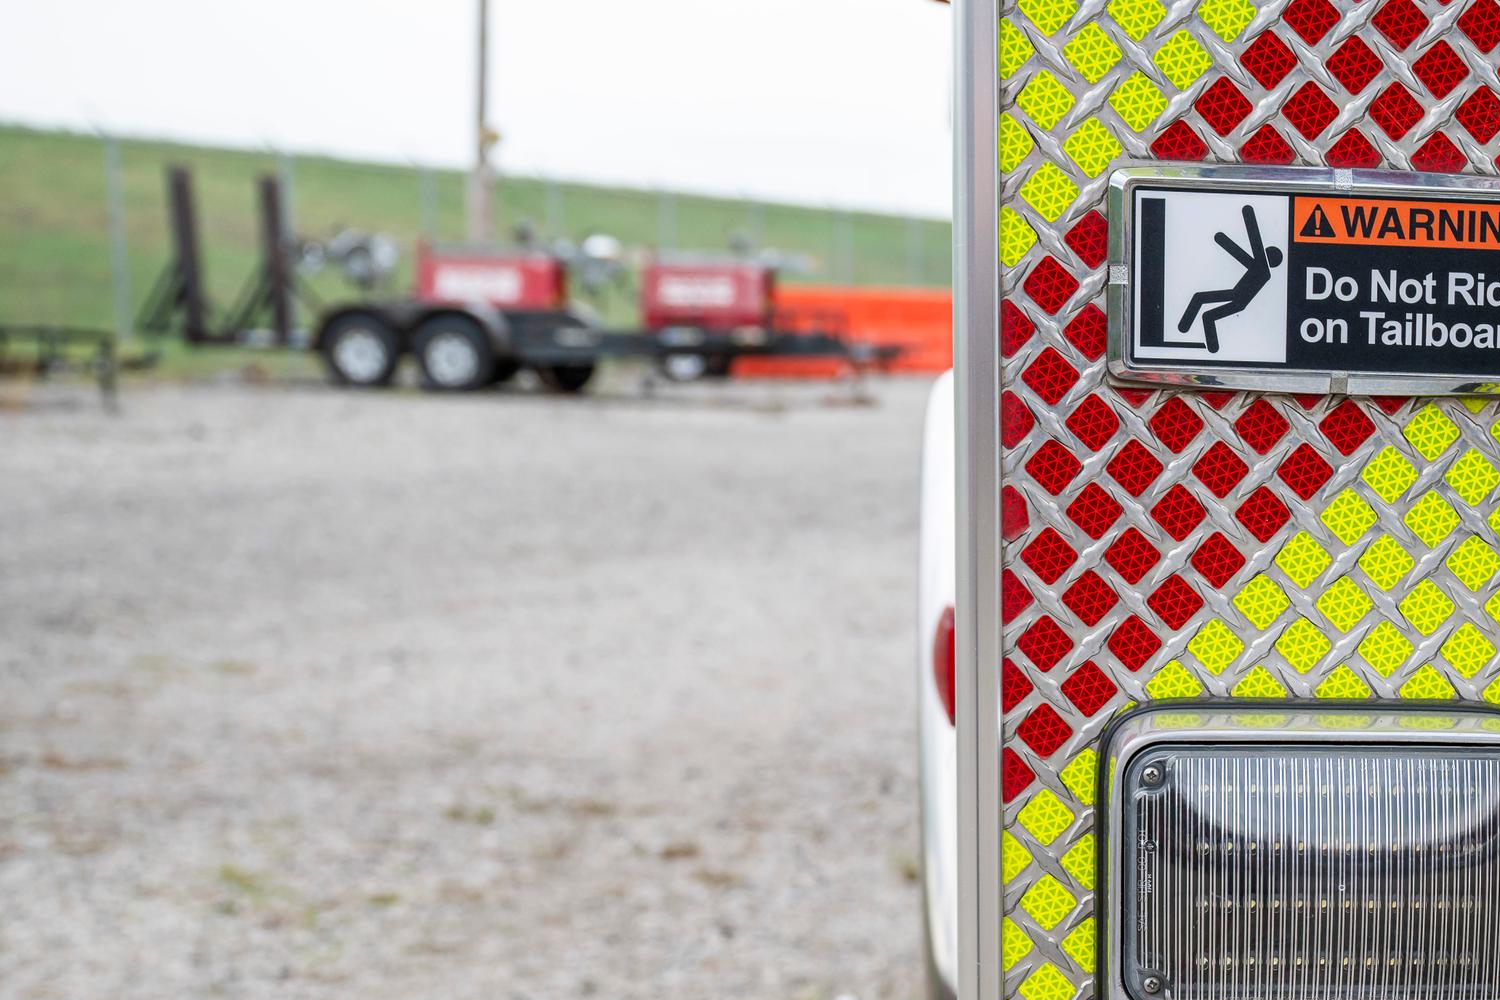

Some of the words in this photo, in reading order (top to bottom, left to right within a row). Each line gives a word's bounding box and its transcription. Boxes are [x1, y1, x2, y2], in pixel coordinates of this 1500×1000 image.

[1305, 266, 1359, 302] Do
[1370, 269, 1437, 305] Not
[1300, 317, 1348, 344] on
